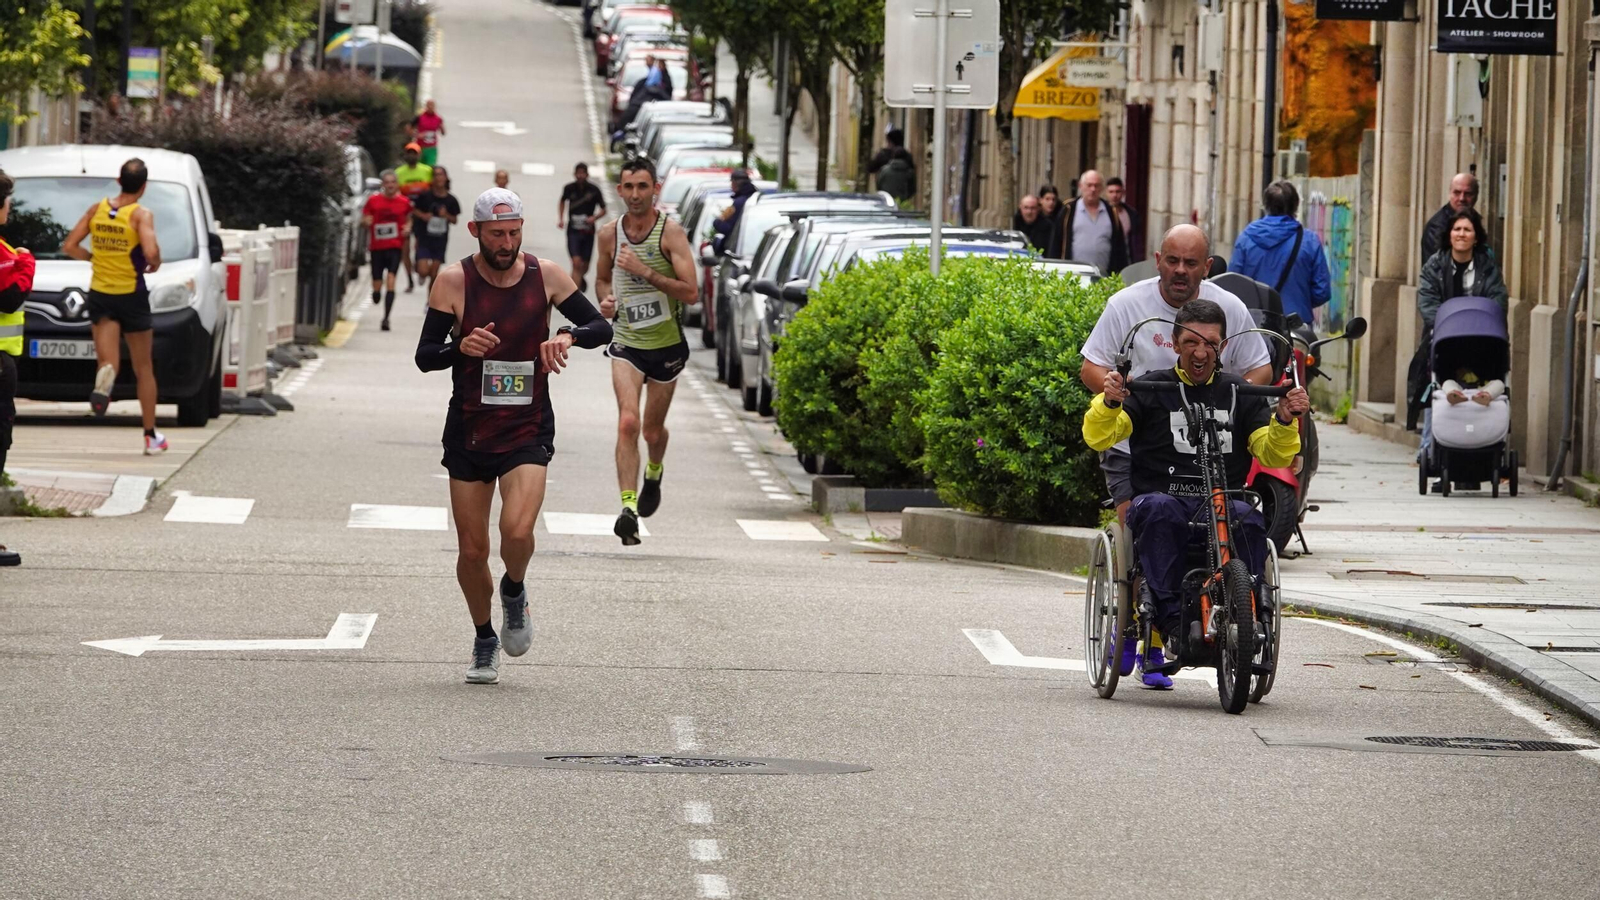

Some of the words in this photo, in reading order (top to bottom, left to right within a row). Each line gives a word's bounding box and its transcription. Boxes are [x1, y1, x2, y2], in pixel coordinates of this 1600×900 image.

[1450, 29, 1484, 37] ATELIER
[1033, 89, 1097, 107] BREZO
[95, 223, 125, 235] ROBER
[630, 303, 656, 321] 796
[40, 342, 77, 357] 0700
[491, 375, 525, 393] 595
[1169, 483, 1180, 491] EU
